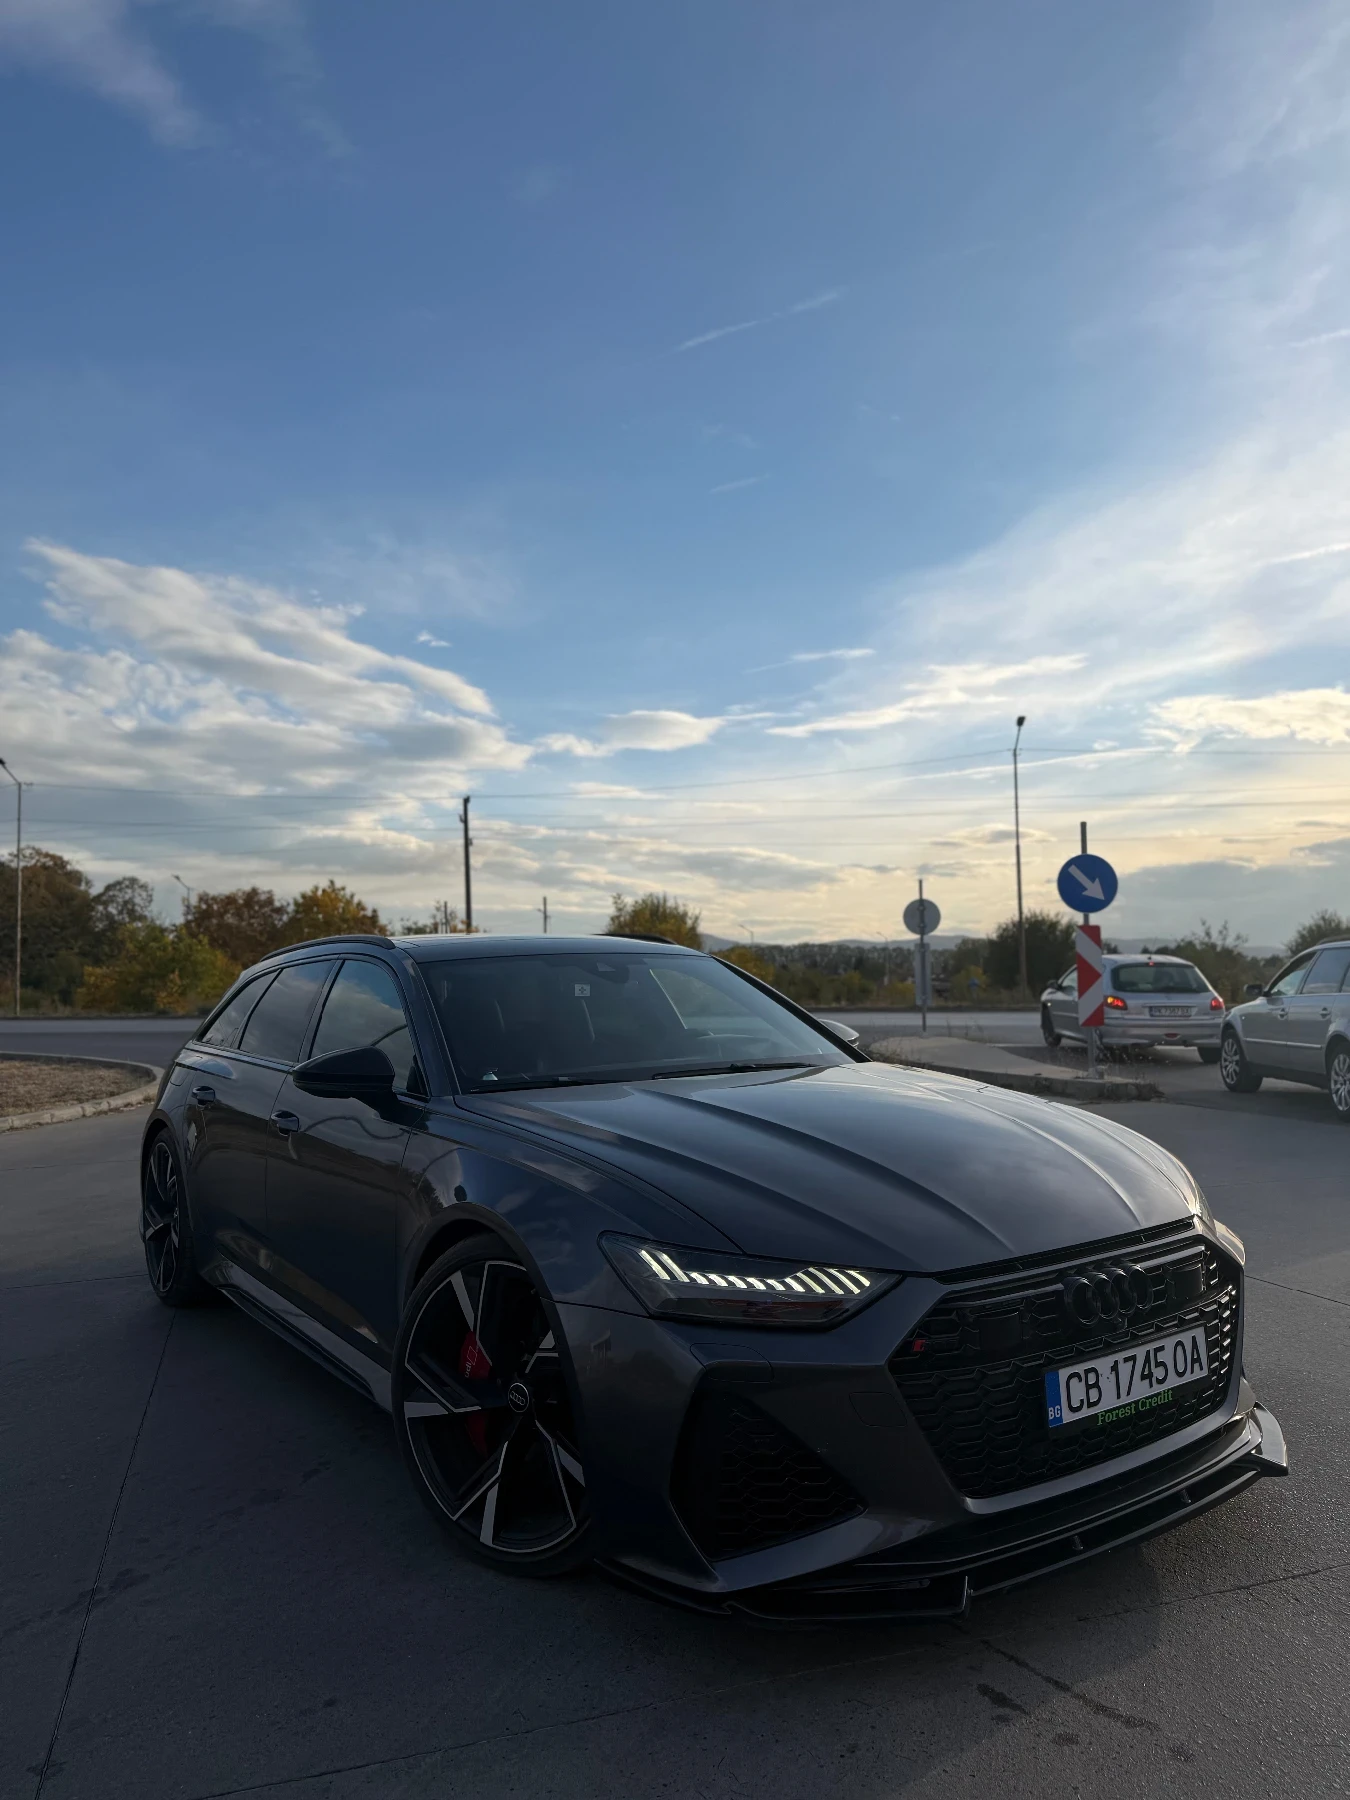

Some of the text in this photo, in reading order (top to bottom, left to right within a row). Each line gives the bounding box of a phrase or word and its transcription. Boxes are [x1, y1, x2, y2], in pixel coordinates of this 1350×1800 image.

[1065, 1334, 1204, 1413] CB 1745 OA
[1048, 1405, 1062, 1420] BG
[1096, 1389, 1173, 1426] Forest Credit
